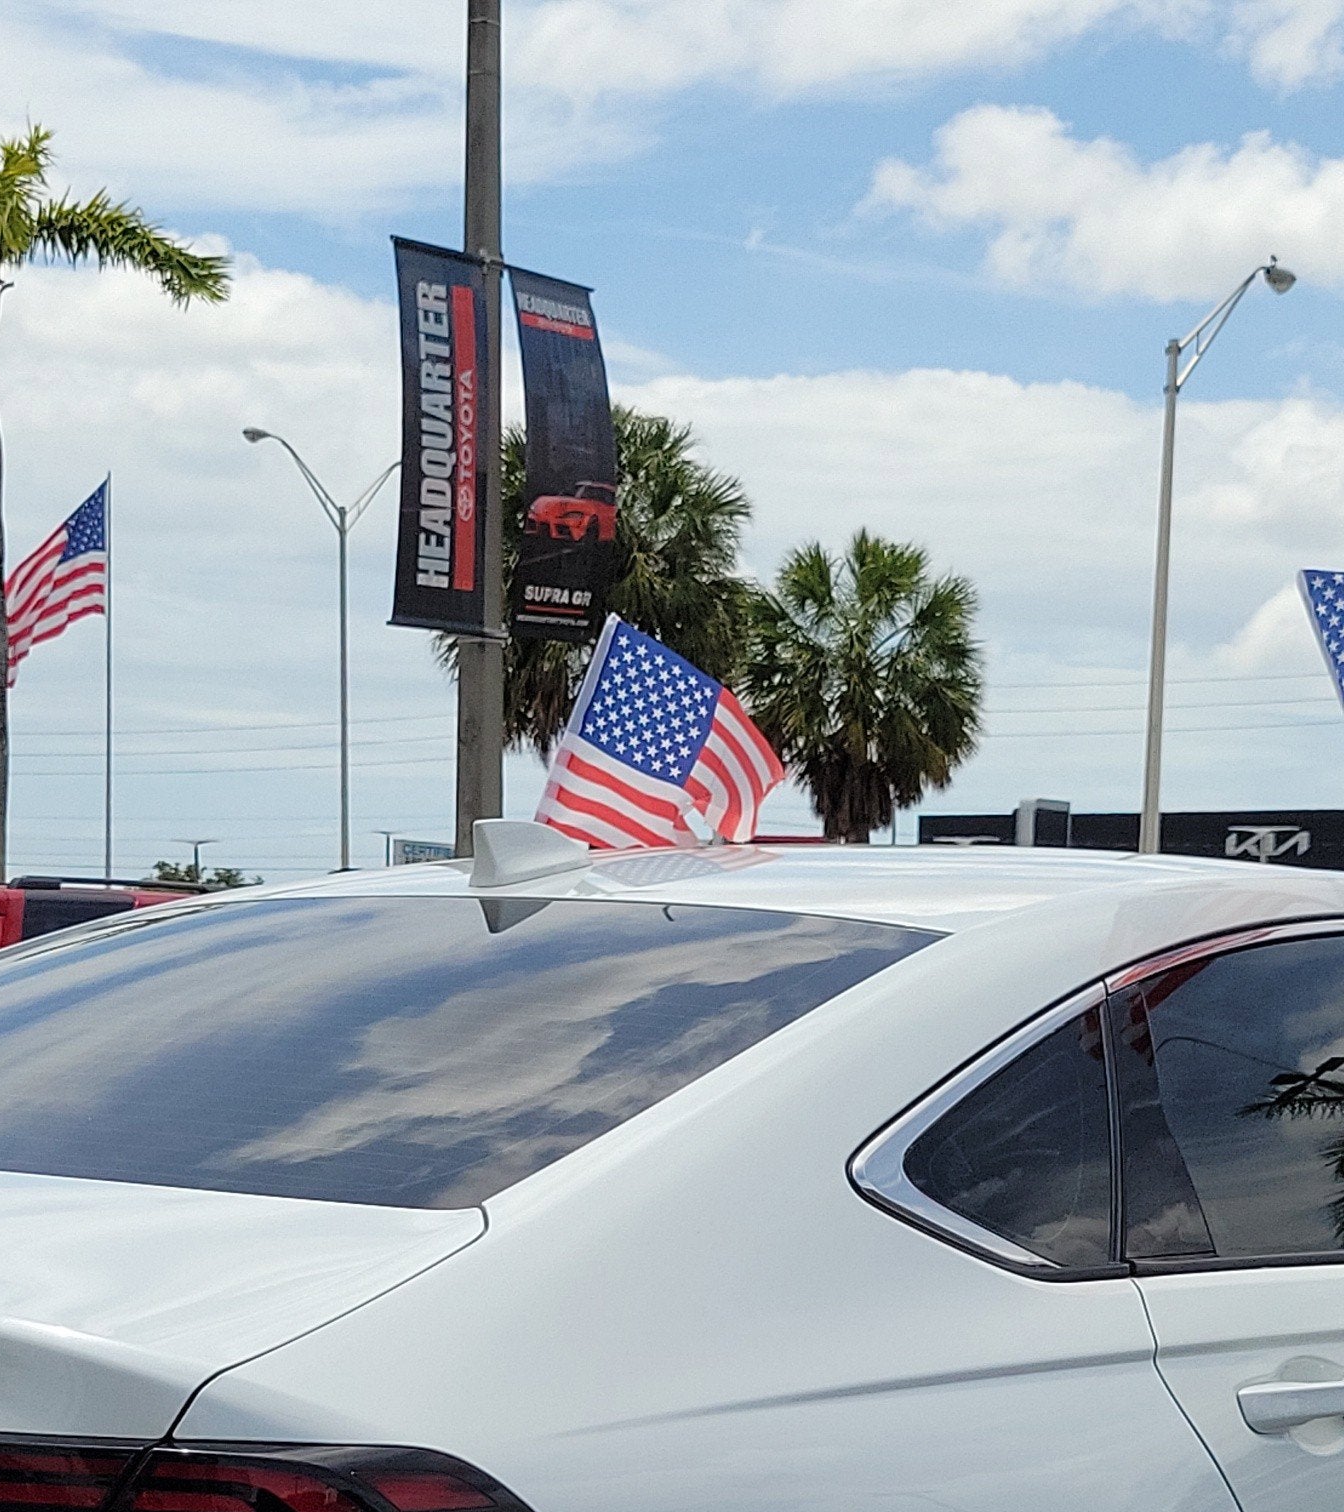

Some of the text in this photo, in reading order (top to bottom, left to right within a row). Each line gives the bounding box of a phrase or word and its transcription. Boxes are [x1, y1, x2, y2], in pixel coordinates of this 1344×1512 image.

[416, 281, 456, 589] HEADQUARTER
[458, 369, 474, 482] TOYOTA
[524, 584, 592, 607] SUPRA GR
